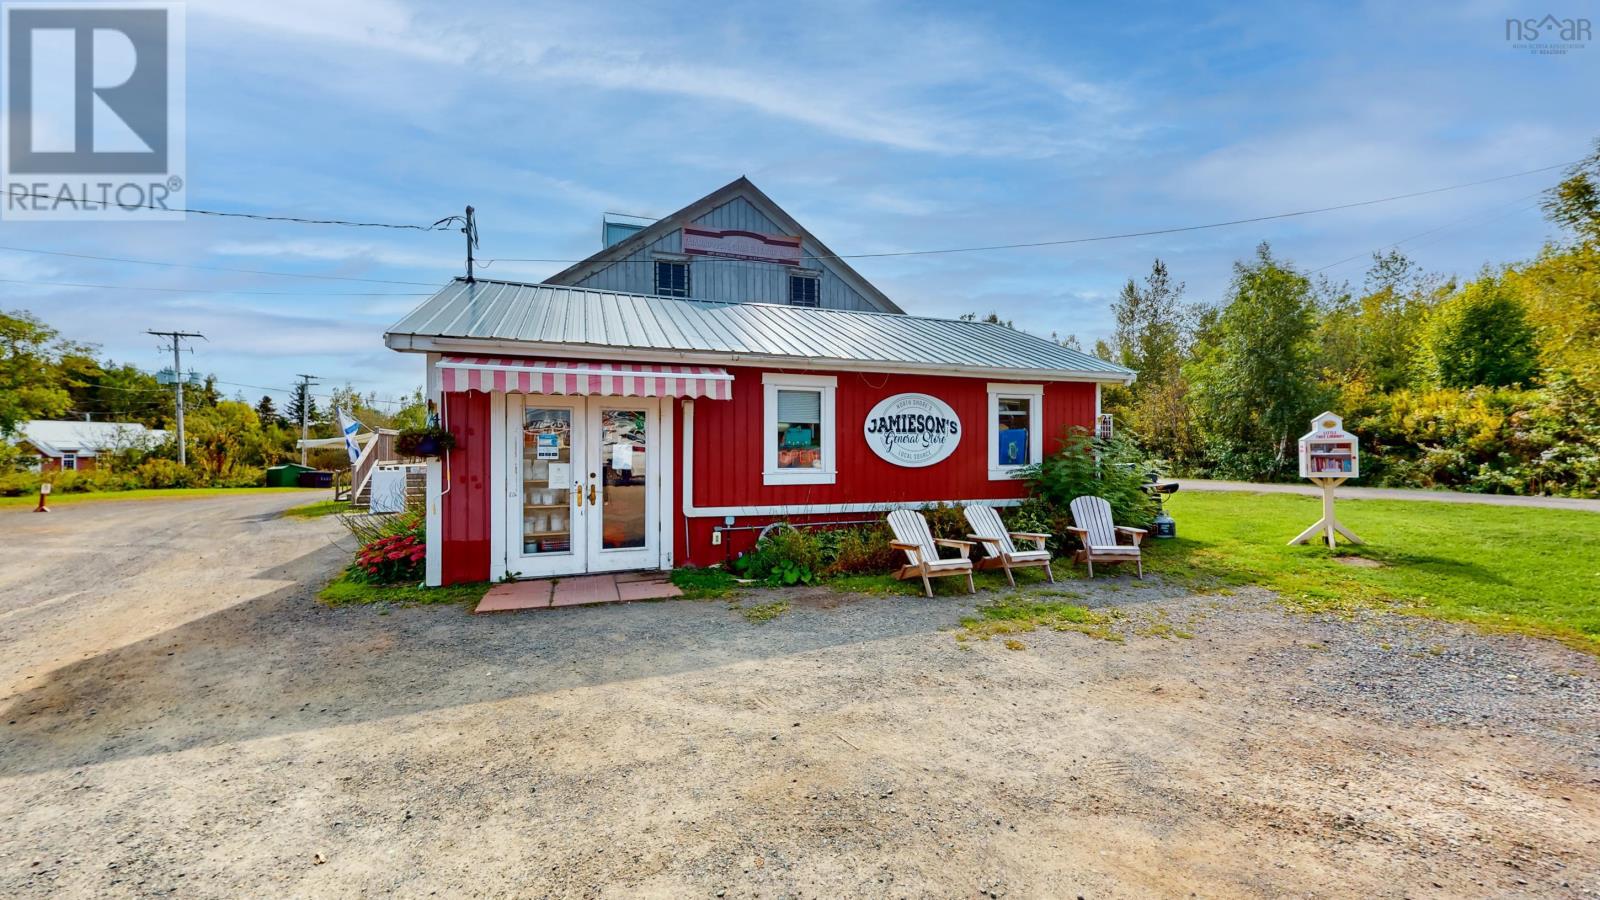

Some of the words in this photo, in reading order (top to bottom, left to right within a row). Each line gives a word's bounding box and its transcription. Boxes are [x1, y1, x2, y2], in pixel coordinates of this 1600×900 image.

[867, 413, 958, 434] JAMIESON'S
[884, 430, 919, 453] General
[921, 430, 946, 448] Store
